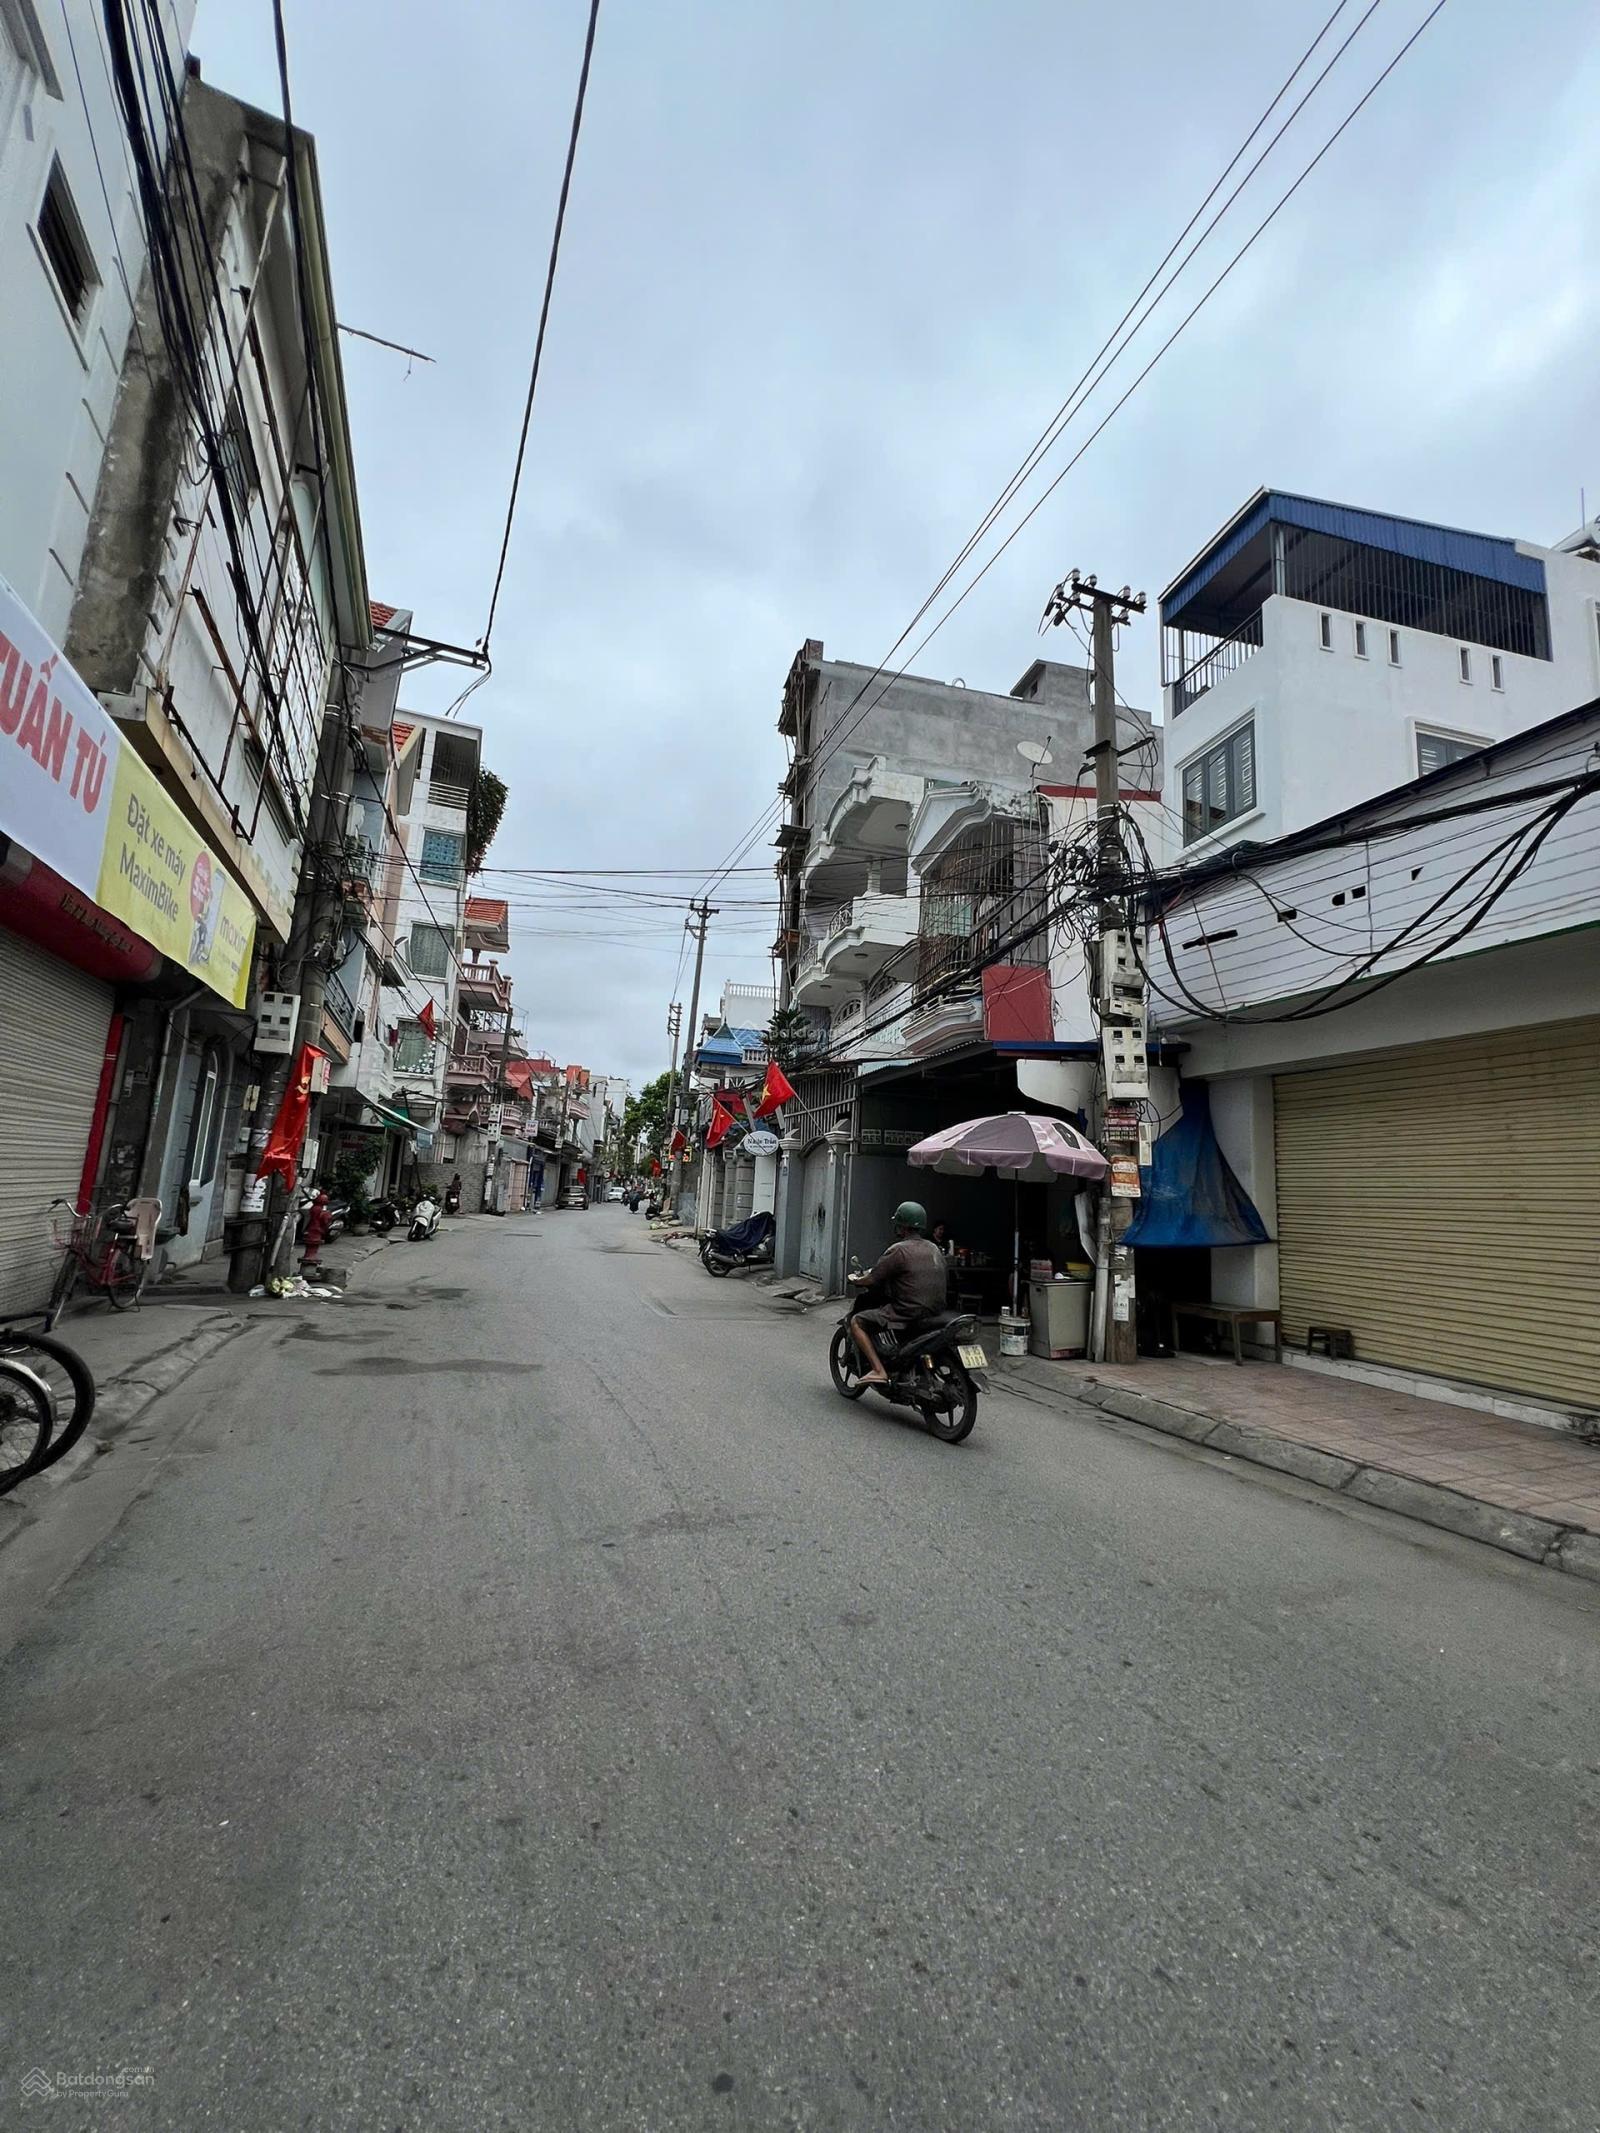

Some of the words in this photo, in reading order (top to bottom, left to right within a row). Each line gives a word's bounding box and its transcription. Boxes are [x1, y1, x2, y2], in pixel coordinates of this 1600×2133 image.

[69, 727, 108, 814] TÚ
[119, 841, 179, 922] MaximBike
[128, 792, 150, 845] Đặt
[151, 828, 164, 858] xe
[164, 844, 186, 886] máy
